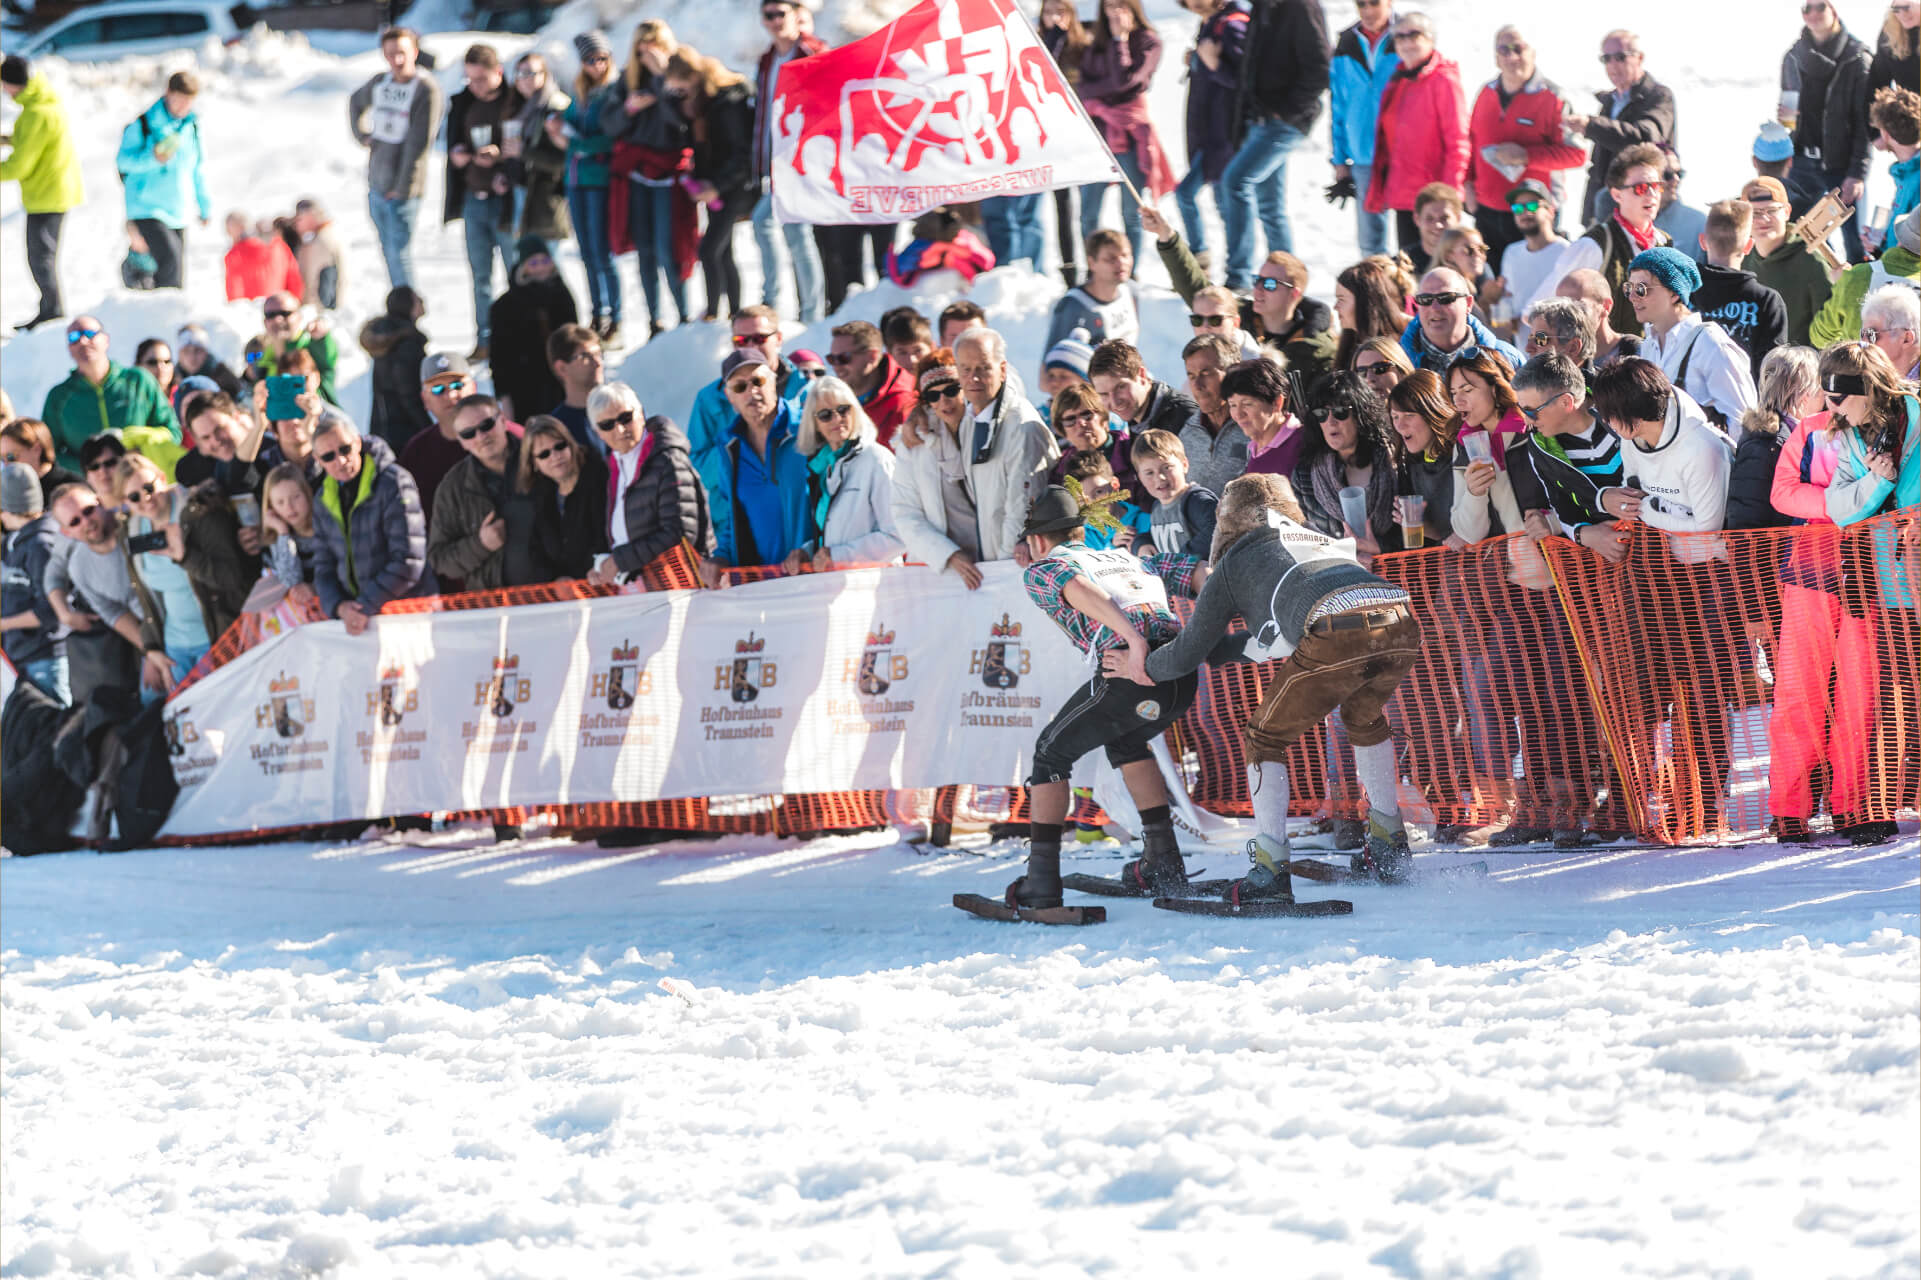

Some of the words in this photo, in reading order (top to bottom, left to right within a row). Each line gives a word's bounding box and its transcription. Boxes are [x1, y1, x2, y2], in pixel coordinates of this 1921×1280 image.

[841, 657, 860, 682] H
[892, 655, 908, 680] B
[969, 649, 987, 675] H
[591, 673, 608, 697] H
[637, 671, 653, 695] B
[714, 665, 731, 690] H
[761, 663, 777, 687] B
[404, 688, 418, 712] B
[474, 681, 491, 706] H
[517, 679, 531, 702] B
